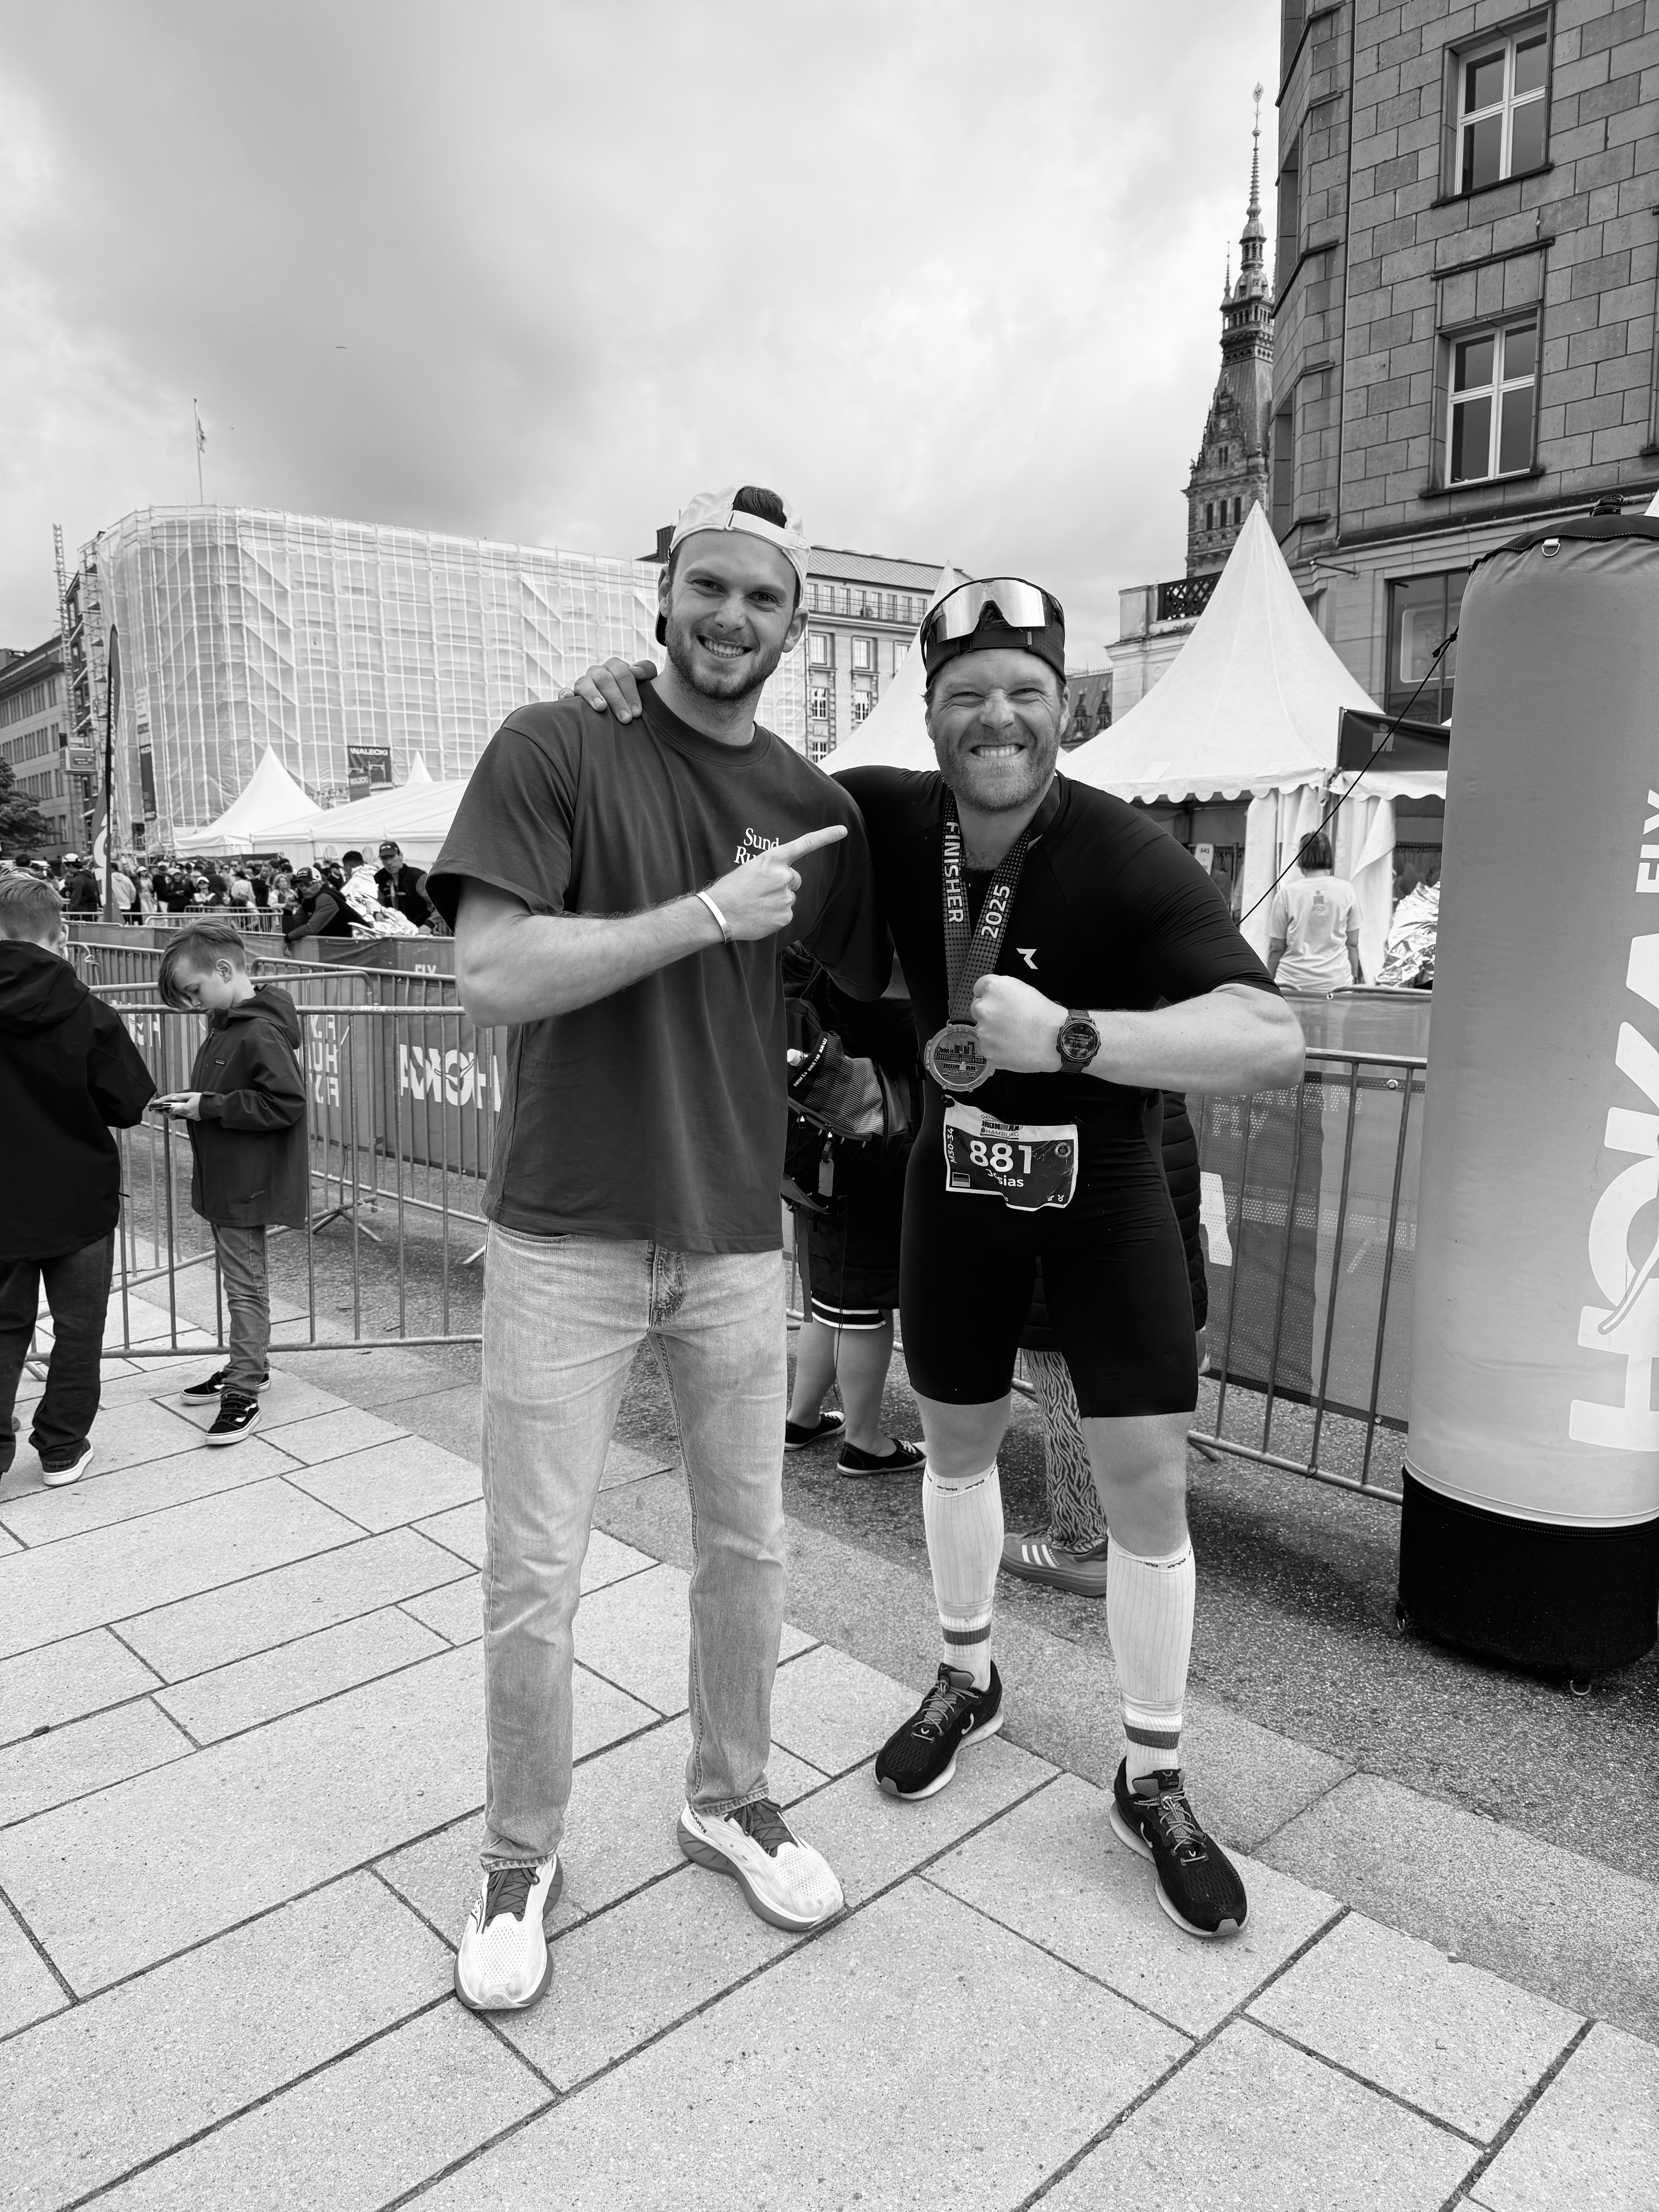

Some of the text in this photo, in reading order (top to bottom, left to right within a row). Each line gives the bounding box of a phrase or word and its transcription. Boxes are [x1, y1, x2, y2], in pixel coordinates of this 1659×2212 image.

[744, 828, 780, 850] Sund
[944, 822, 964, 922] FINISHER
[981, 884, 1010, 939] 2025
[982, 1120, 1020, 1132] IRONMAN
[986, 1128, 1019, 1137] HAMBURG
[947, 1128, 957, 1164] M30-34
[970, 1140, 1031, 1174] 881
[689, 1803, 707, 1834] ucony
